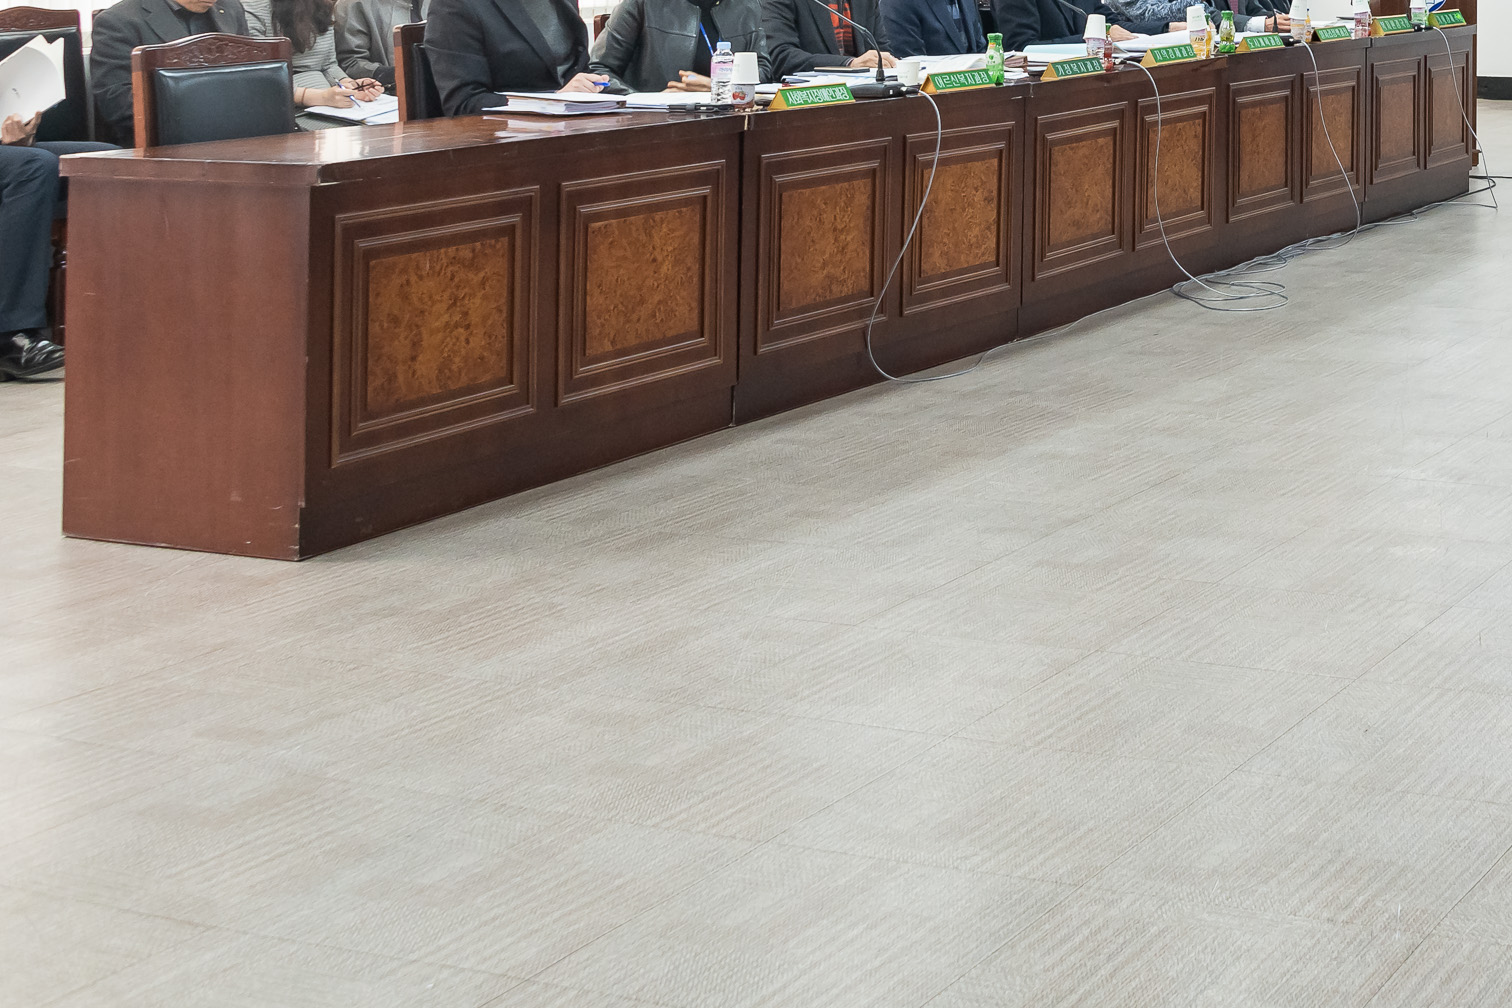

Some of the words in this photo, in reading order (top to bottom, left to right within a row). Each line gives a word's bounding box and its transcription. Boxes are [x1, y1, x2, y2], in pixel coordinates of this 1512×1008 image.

[1153, 45, 1194, 61] 지역경제과장
[1055, 59, 1101, 76] 가정복지과장
[934, 71, 990, 89] 어르신복지과장
